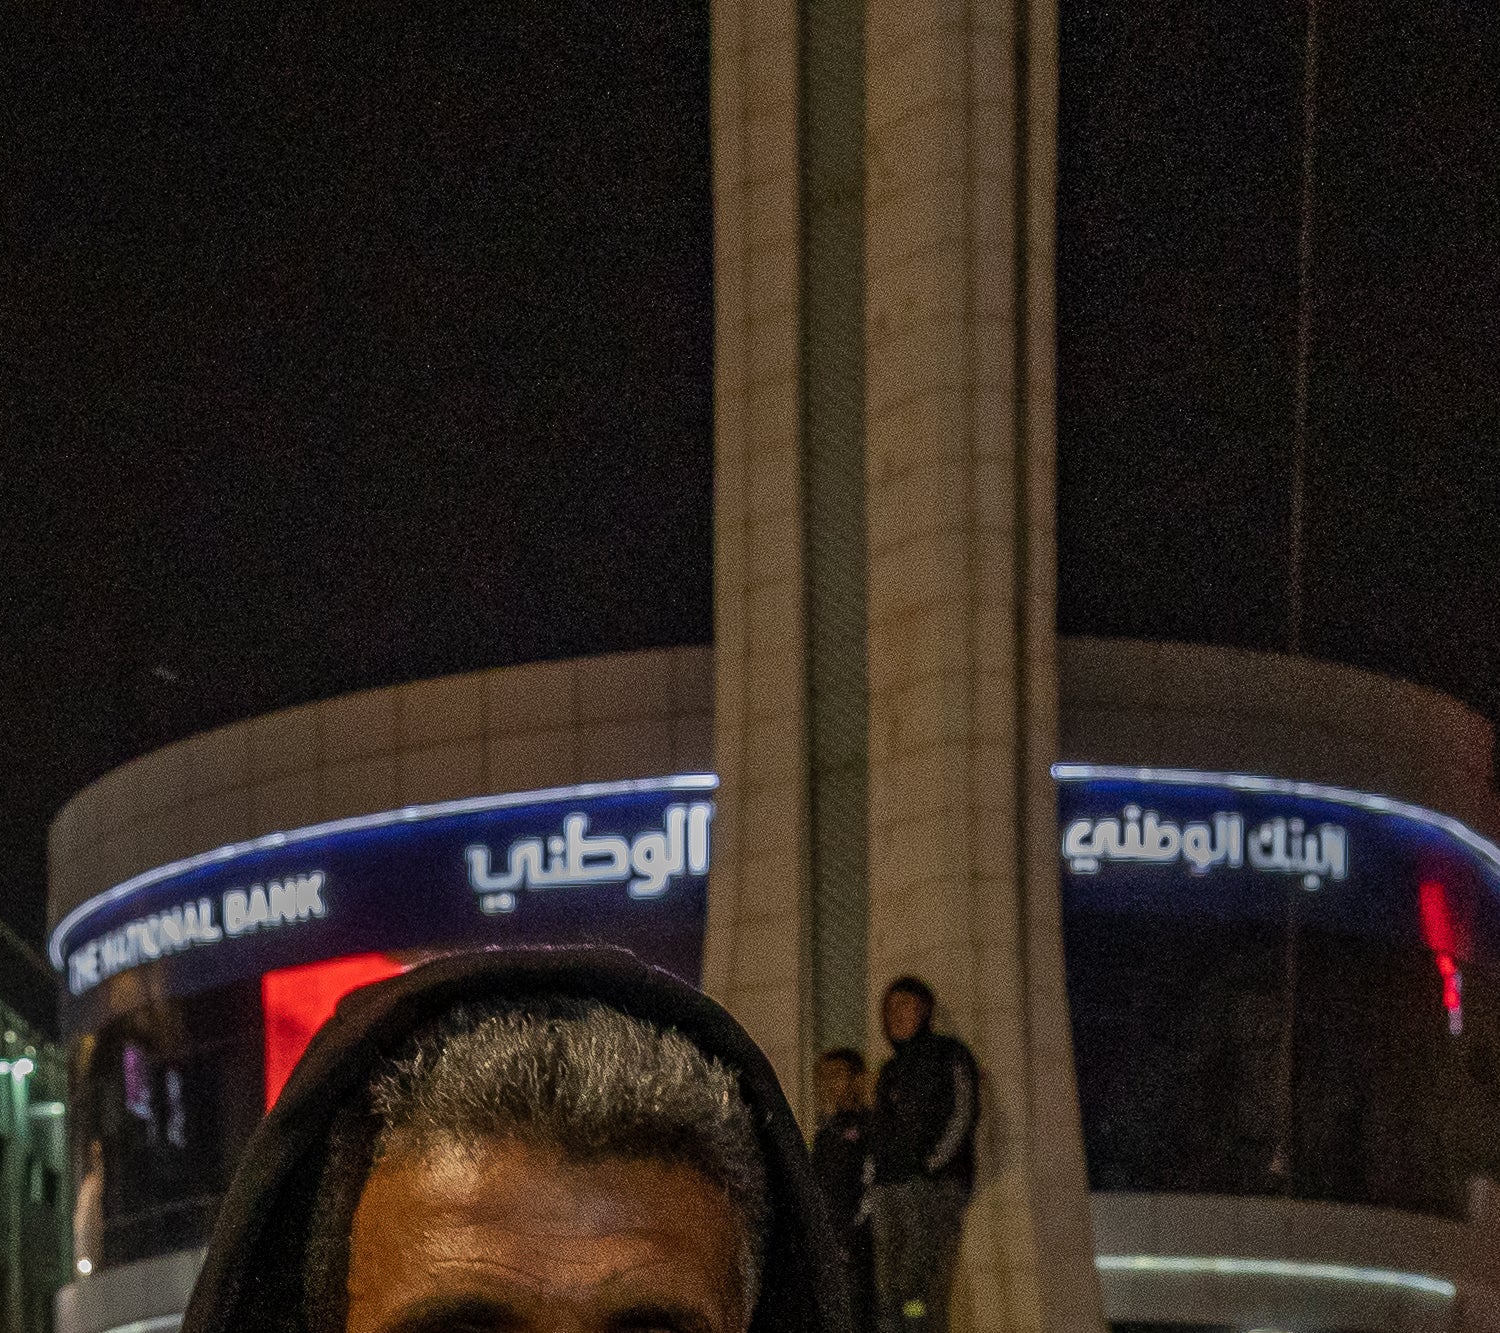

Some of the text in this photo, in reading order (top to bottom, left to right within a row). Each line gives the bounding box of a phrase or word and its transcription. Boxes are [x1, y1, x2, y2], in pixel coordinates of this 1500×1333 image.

[465, 799, 716, 913] الوطني
[1062, 802, 1346, 890] البنك الوطني
[222, 868, 328, 938] BANK
